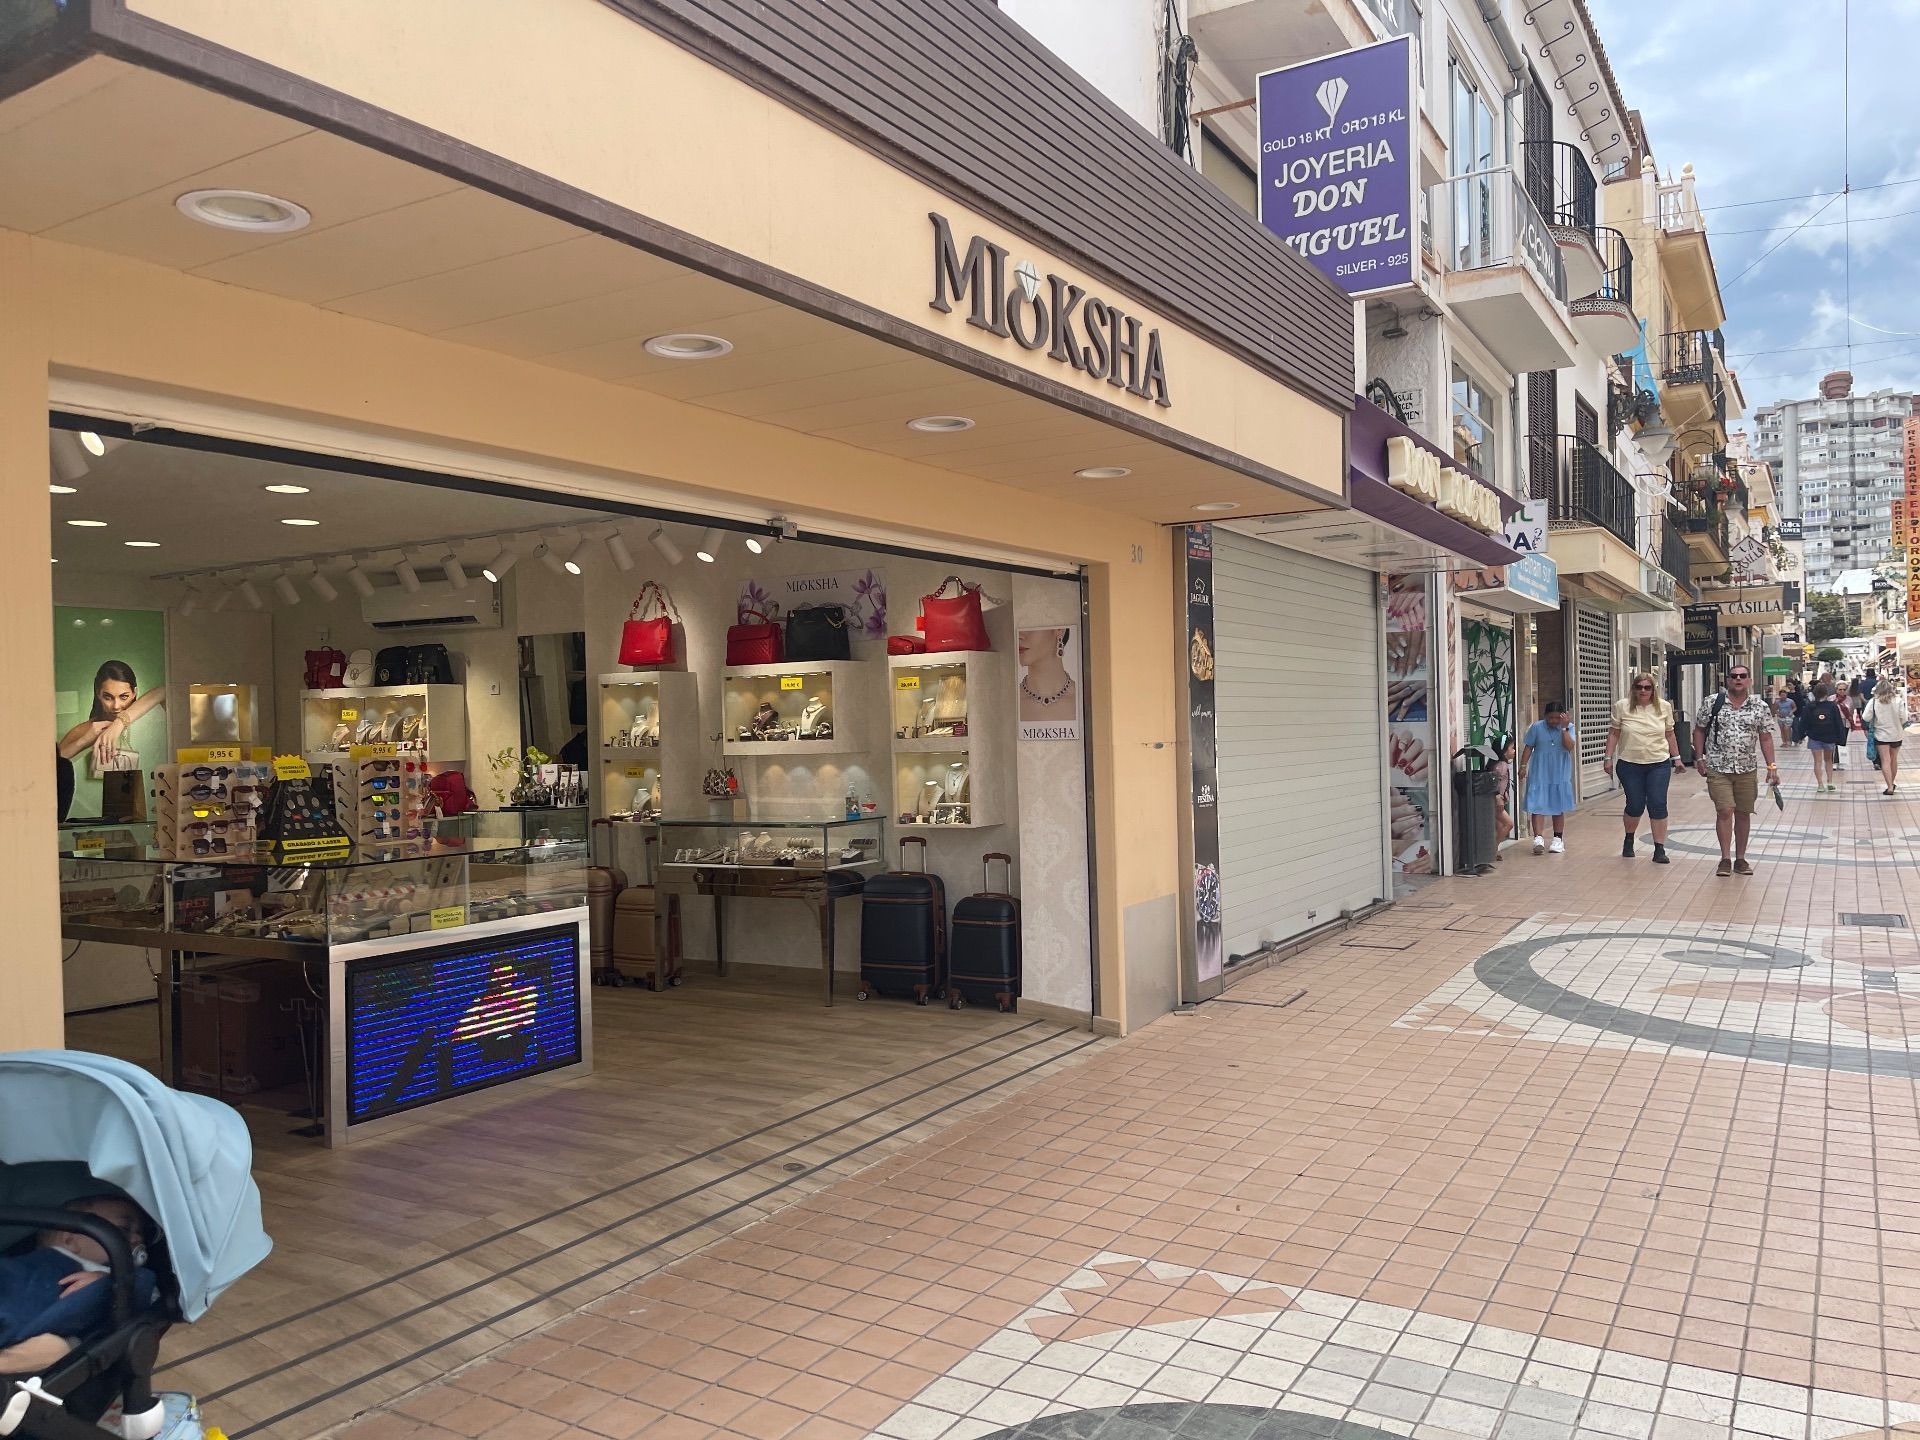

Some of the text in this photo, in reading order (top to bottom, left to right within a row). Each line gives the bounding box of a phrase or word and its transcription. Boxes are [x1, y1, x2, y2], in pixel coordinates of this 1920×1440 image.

[1341, 108, 1406, 135] ORO 18 KL
[1263, 126, 1332, 153] GOLD 18 KT
[1274, 139, 1395, 188] JOYERIA
[1292, 178, 1368, 218] DON
[1336, 259, 1377, 276] SILVER
[1387, 252, 1409, 267] 925
[928, 211, 1171, 408] MIOKSHA
[1907, 430, 1917, 496] RESTAURANTE
[1909, 500, 1919, 519] EL
[1130, 543, 1143, 564] 30
[1910, 526, 1920, 566] TORO
[1734, 547, 1765, 574] CASILLA
[785, 577, 839, 593] MIOKSHA
[1911, 573, 1920, 613] AZUL
[1729, 600, 1781, 615] CASILLA
[1023, 727, 1075, 739] MIOKSHA
[209, 750, 234, 759] 9,95 €
[371, 746, 393, 755] 9,95 €
